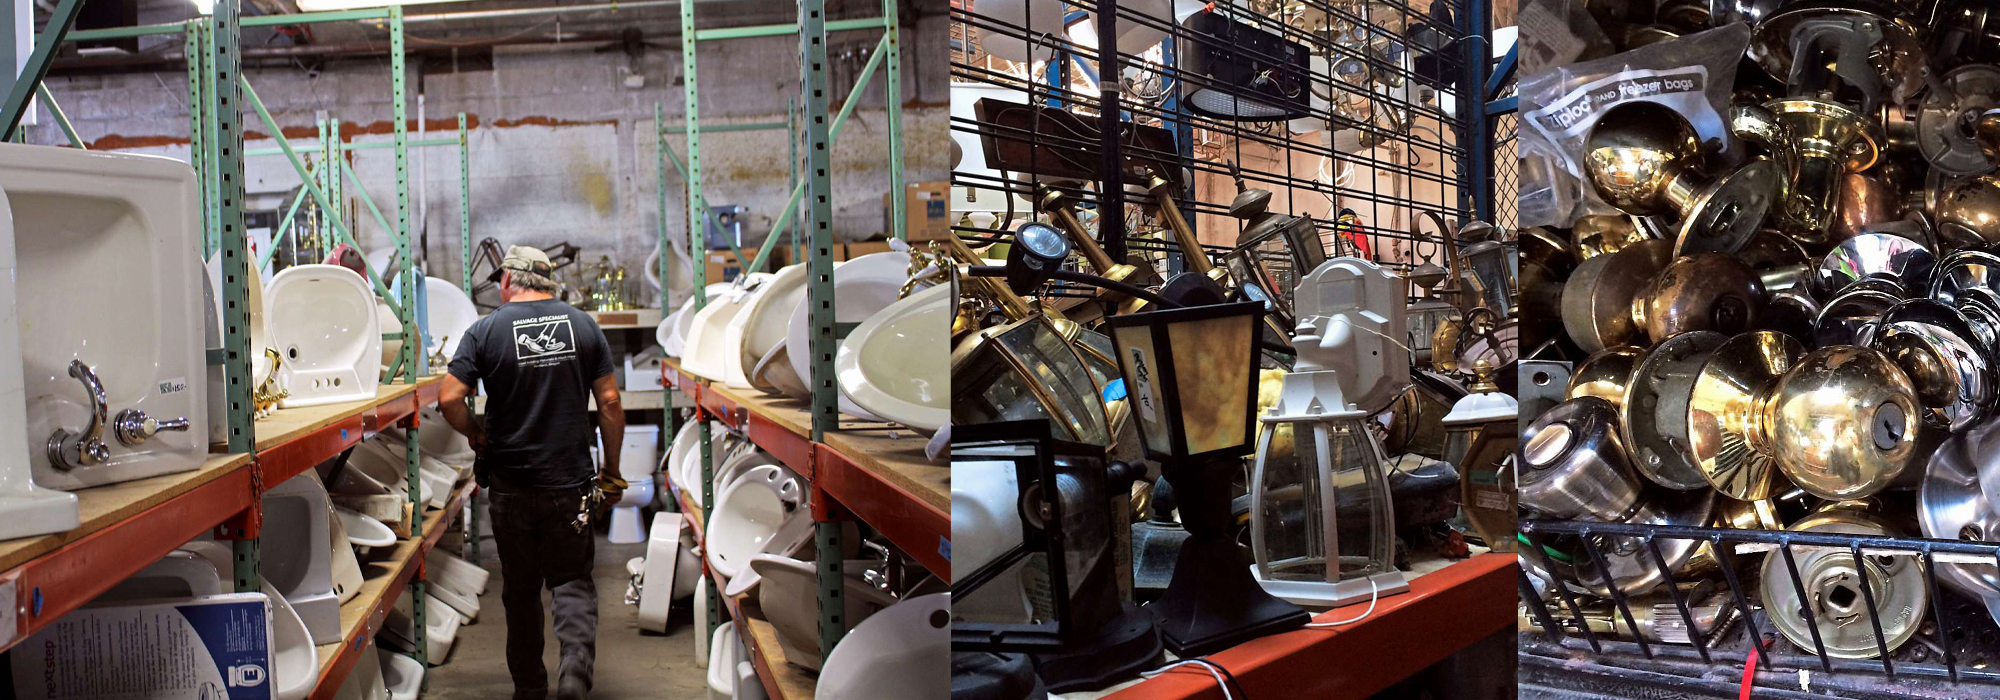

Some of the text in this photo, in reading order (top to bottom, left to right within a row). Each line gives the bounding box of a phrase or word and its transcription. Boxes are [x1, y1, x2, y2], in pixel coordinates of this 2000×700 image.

[1618, 80, 1661, 99] freezer
[1664, 79, 1694, 91] bags
[513, 314, 568, 326] SALVAGE SPECIALIST
[44, 641, 56, 698] nextstep
[244, 670, 258, 680] E
